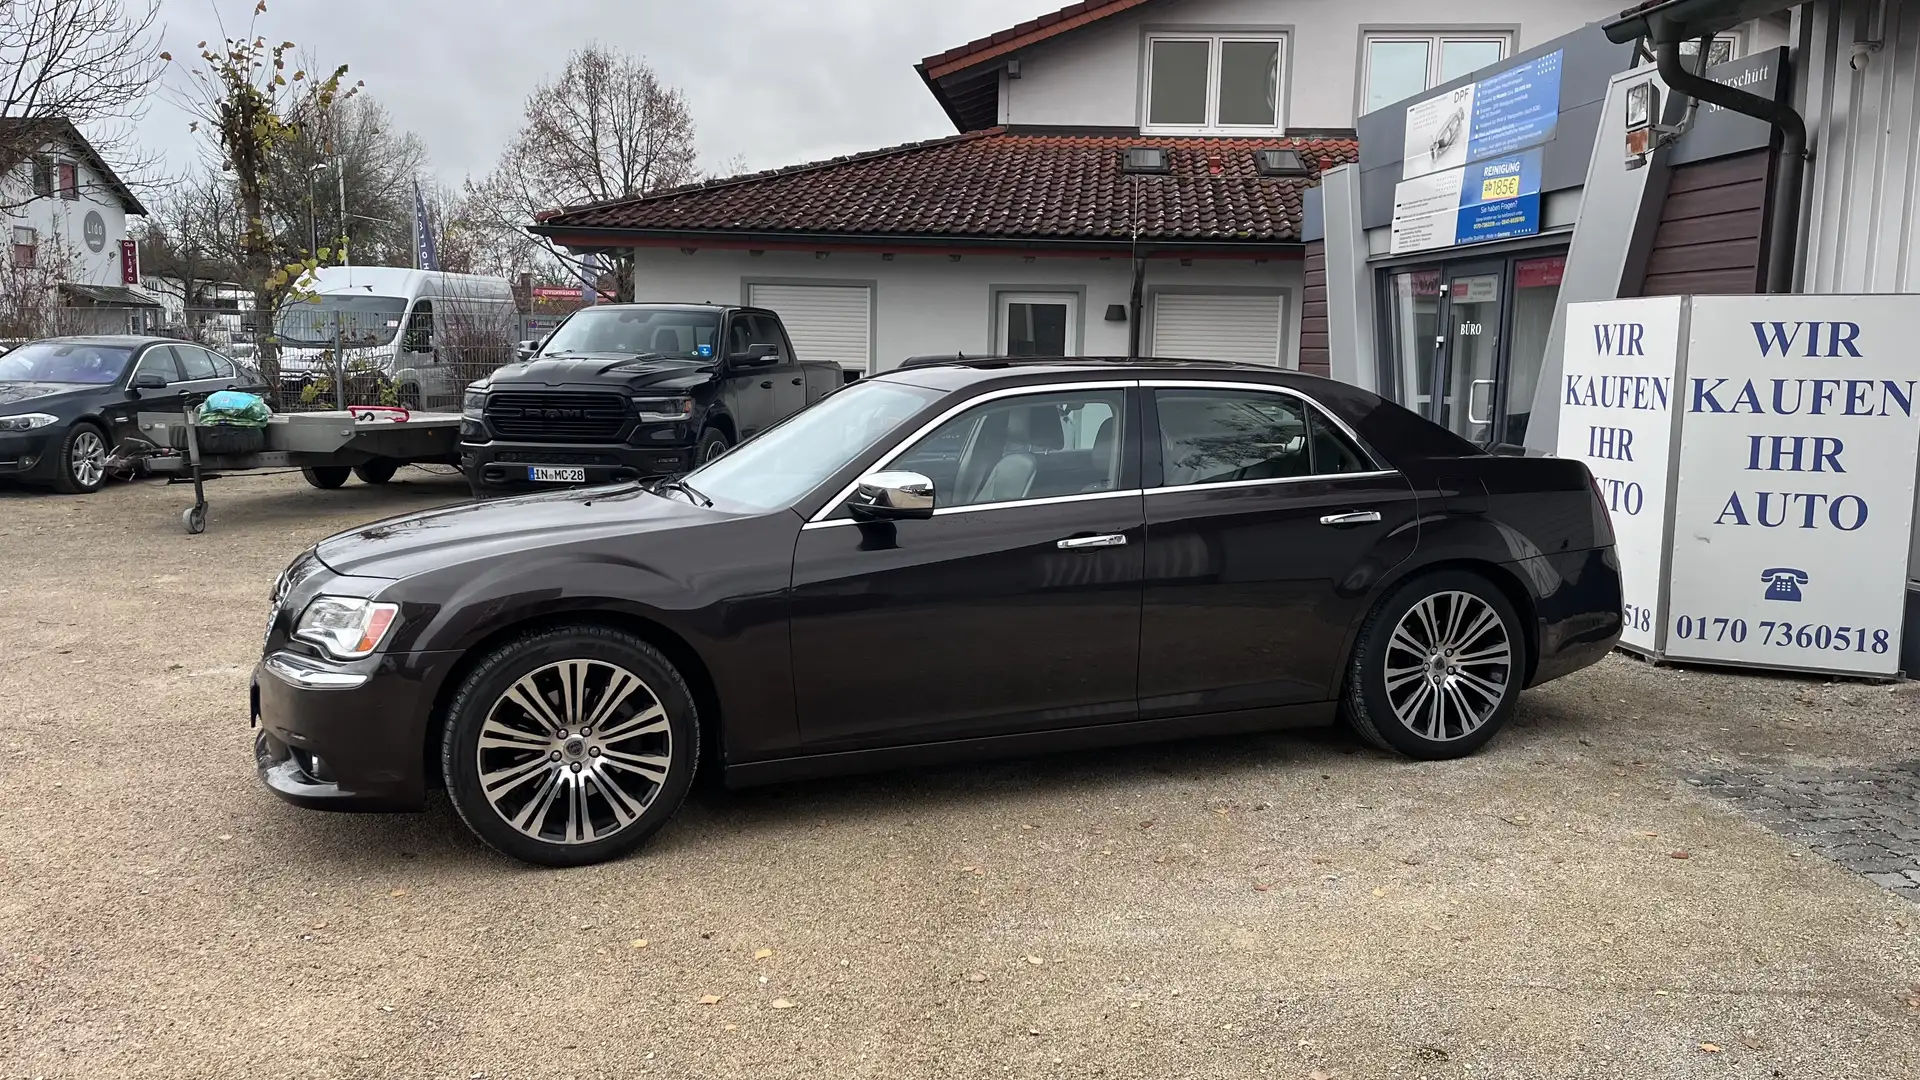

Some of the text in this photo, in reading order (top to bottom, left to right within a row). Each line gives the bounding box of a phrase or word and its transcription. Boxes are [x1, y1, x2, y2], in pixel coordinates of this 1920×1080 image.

[1454, 87, 1470, 104] DPF
[1483, 161, 1520, 177] REINIGUNG
[1484, 178, 1517, 196] ab 185€
[1480, 200, 1518, 214] Sie haben Fragen?
[86, 221, 103, 235] Lido
[1460, 320, 1482, 336] BÜRO
[1593, 323, 1645, 356] WIR
[1750, 321, 1864, 358] WIR
[1565, 375, 1670, 412] KAUFEN
[1688, 377, 1918, 418] KAUFEN
[524, 408, 581, 419] RAM
[1588, 426, 1634, 462] IHR
[1744, 435, 1847, 473] IHR
[1713, 490, 1869, 532] AUTO
[1676, 614, 1889, 655] 0170 7360518
